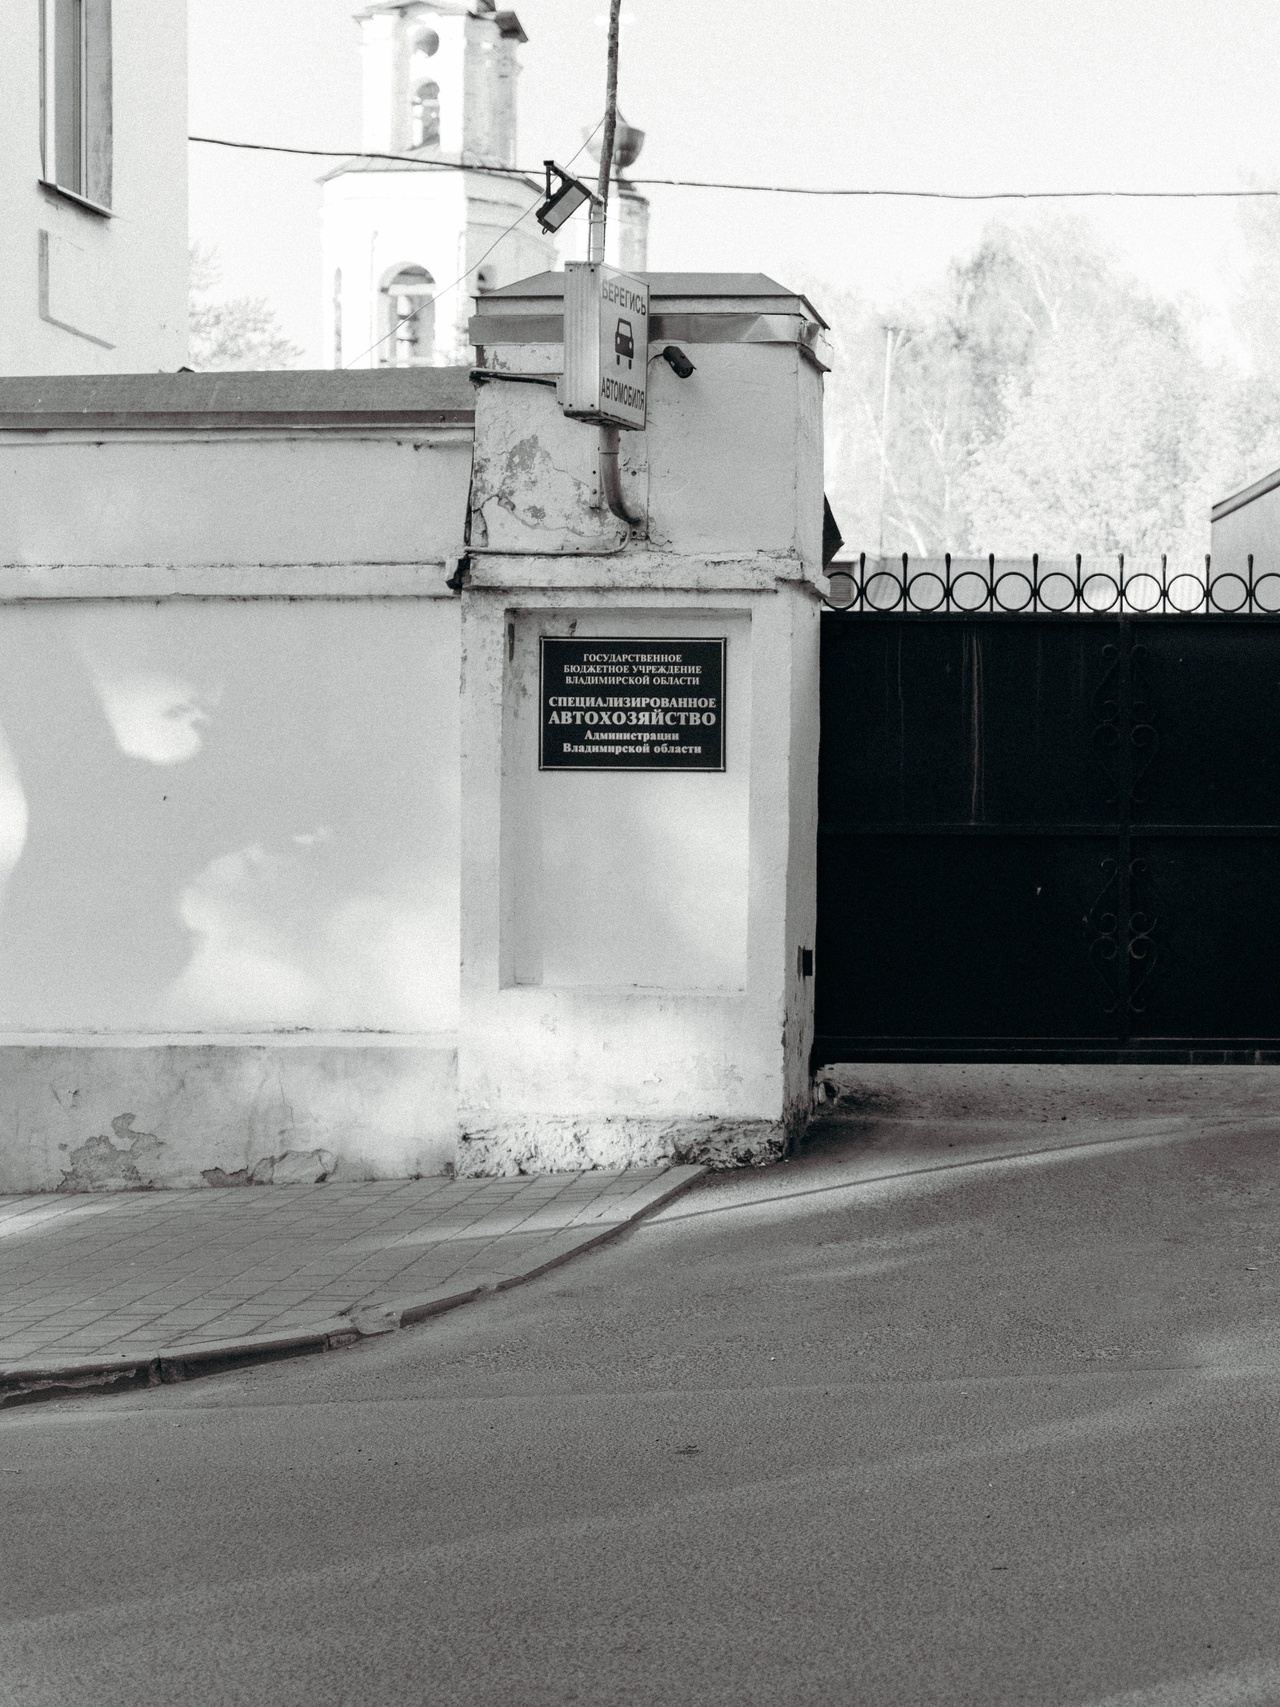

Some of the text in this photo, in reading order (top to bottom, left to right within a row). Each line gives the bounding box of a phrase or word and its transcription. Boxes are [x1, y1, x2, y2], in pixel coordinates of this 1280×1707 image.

[602, 279, 646, 316] БЕРЕГИСЬ
[601, 376, 645, 411] АВТОМОБИЛЯ
[583, 653, 682, 663] ГОСУДАРСТВЕННОЕ
[563, 664, 702, 674] БЮДЖЕТНОЕ УЧРЕЖДЕНИЕ
[565, 675, 700, 685] ВЛАДИМИРСКОЙ ОБЛАСТИ
[548, 697, 717, 708] СПЕЦИАЛИЗИРОВАННОЕ
[548, 709, 717, 725] АВТОХОЗЯЙСТВО
[584, 730, 680, 741] Администрации
[562, 743, 701, 755] Владимирской области
